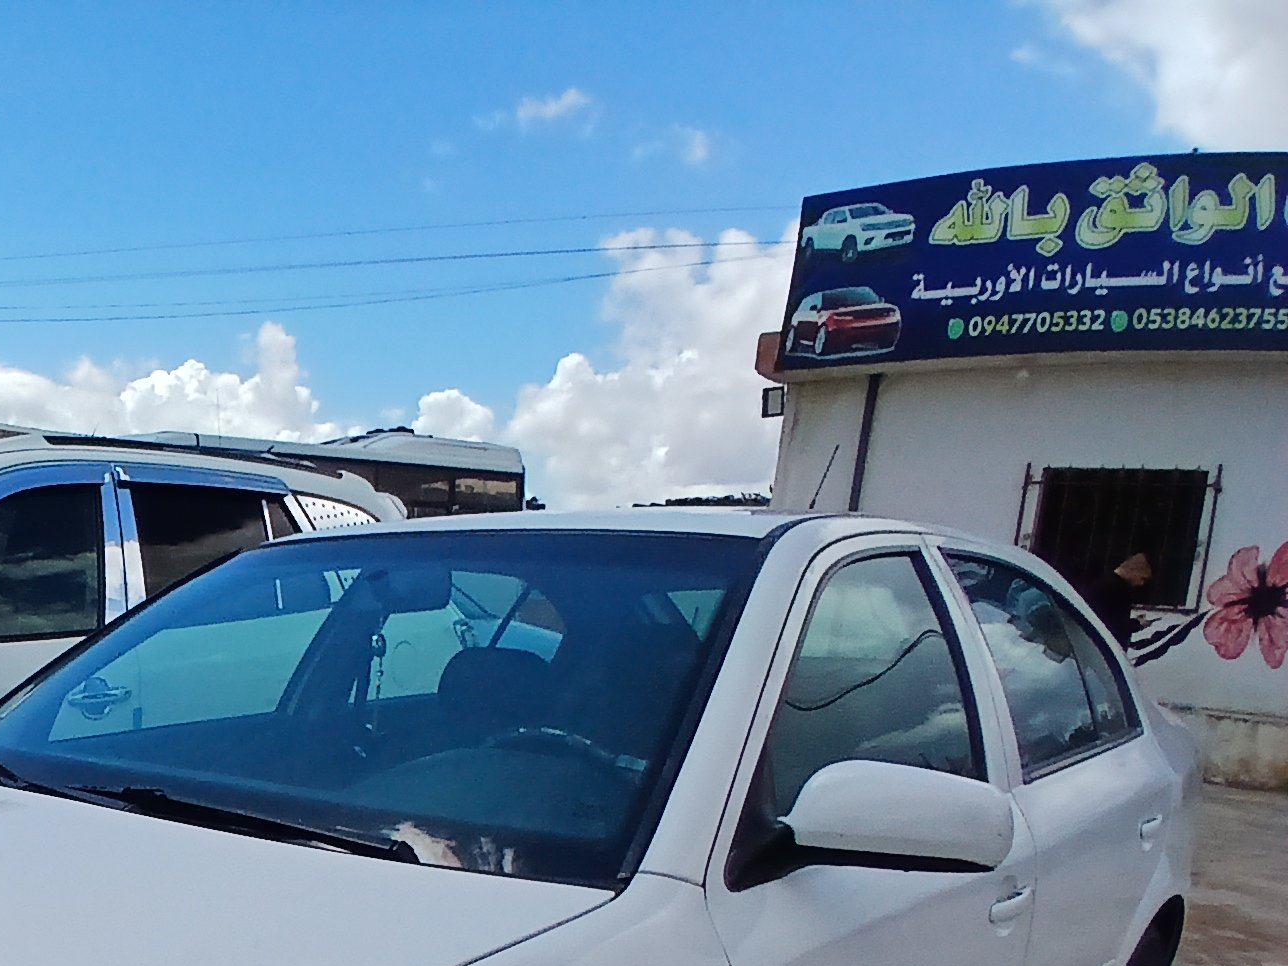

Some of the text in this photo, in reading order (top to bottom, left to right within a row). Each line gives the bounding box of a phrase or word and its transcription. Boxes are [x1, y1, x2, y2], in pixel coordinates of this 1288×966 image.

[928, 162, 1275, 257] الواثق بالله
[911, 263, 1035, 305] الأوربية
[1040, 260, 1180, 296] السيارات
[1184, 253, 1264, 294] أنواع
[968, 309, 1106, 337] 0947705332
